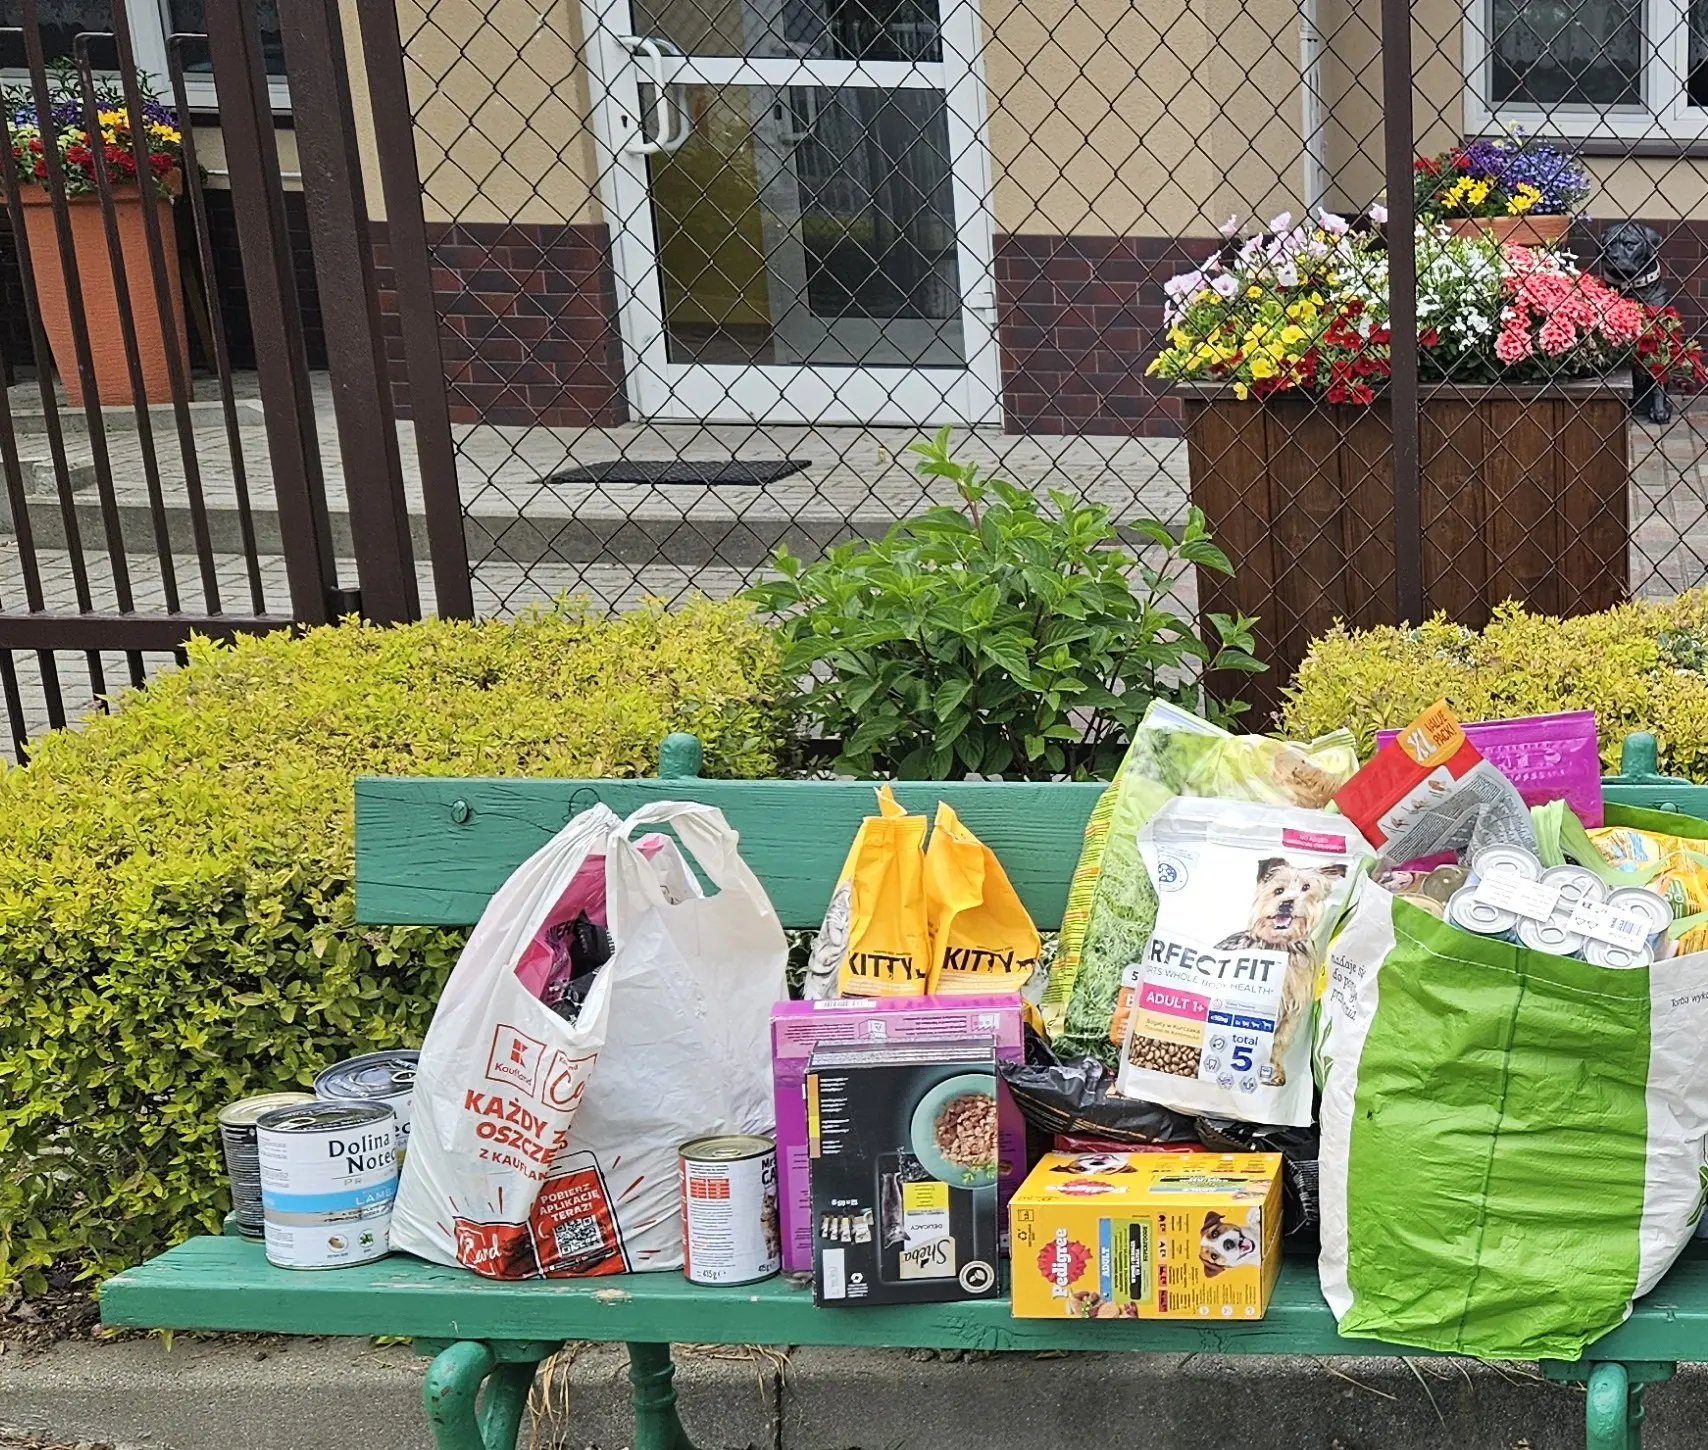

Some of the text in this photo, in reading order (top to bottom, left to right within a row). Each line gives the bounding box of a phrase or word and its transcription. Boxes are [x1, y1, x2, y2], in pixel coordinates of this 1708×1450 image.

[1424, 709, 1448, 732] VALUE
[1407, 727, 1437, 762] XL
[1432, 725, 1458, 748] PACK!
[848, 951, 912, 980] KITTY
[942, 946, 1014, 973] KITTY
[1233, 957, 1275, 982] FIT
[1166, 970, 1198, 984] WHOLE
[1146, 992, 1205, 1012] ADULT 1+
[1232, 1035, 1258, 1046] total
[1230, 1046, 1253, 1072] 5
[494, 1062, 532, 1086] Kaufland
[464, 1088, 548, 1139] KAŻDY
[328, 1132, 390, 1158] Dolina
[479, 1148, 489, 1158] Z
[539, 1189, 602, 1216] APLIKACJĘ
[541, 1184, 591, 1204] POBIERZ
[551, 1203, 592, 1222] TERAZ!
[910, 1223, 943, 1231] DELICACY
[904, 1239, 950, 1266] Sheba
[1052, 1228, 1069, 1299] Pedigree
[1102, 1246, 1110, 1277] ADULT
